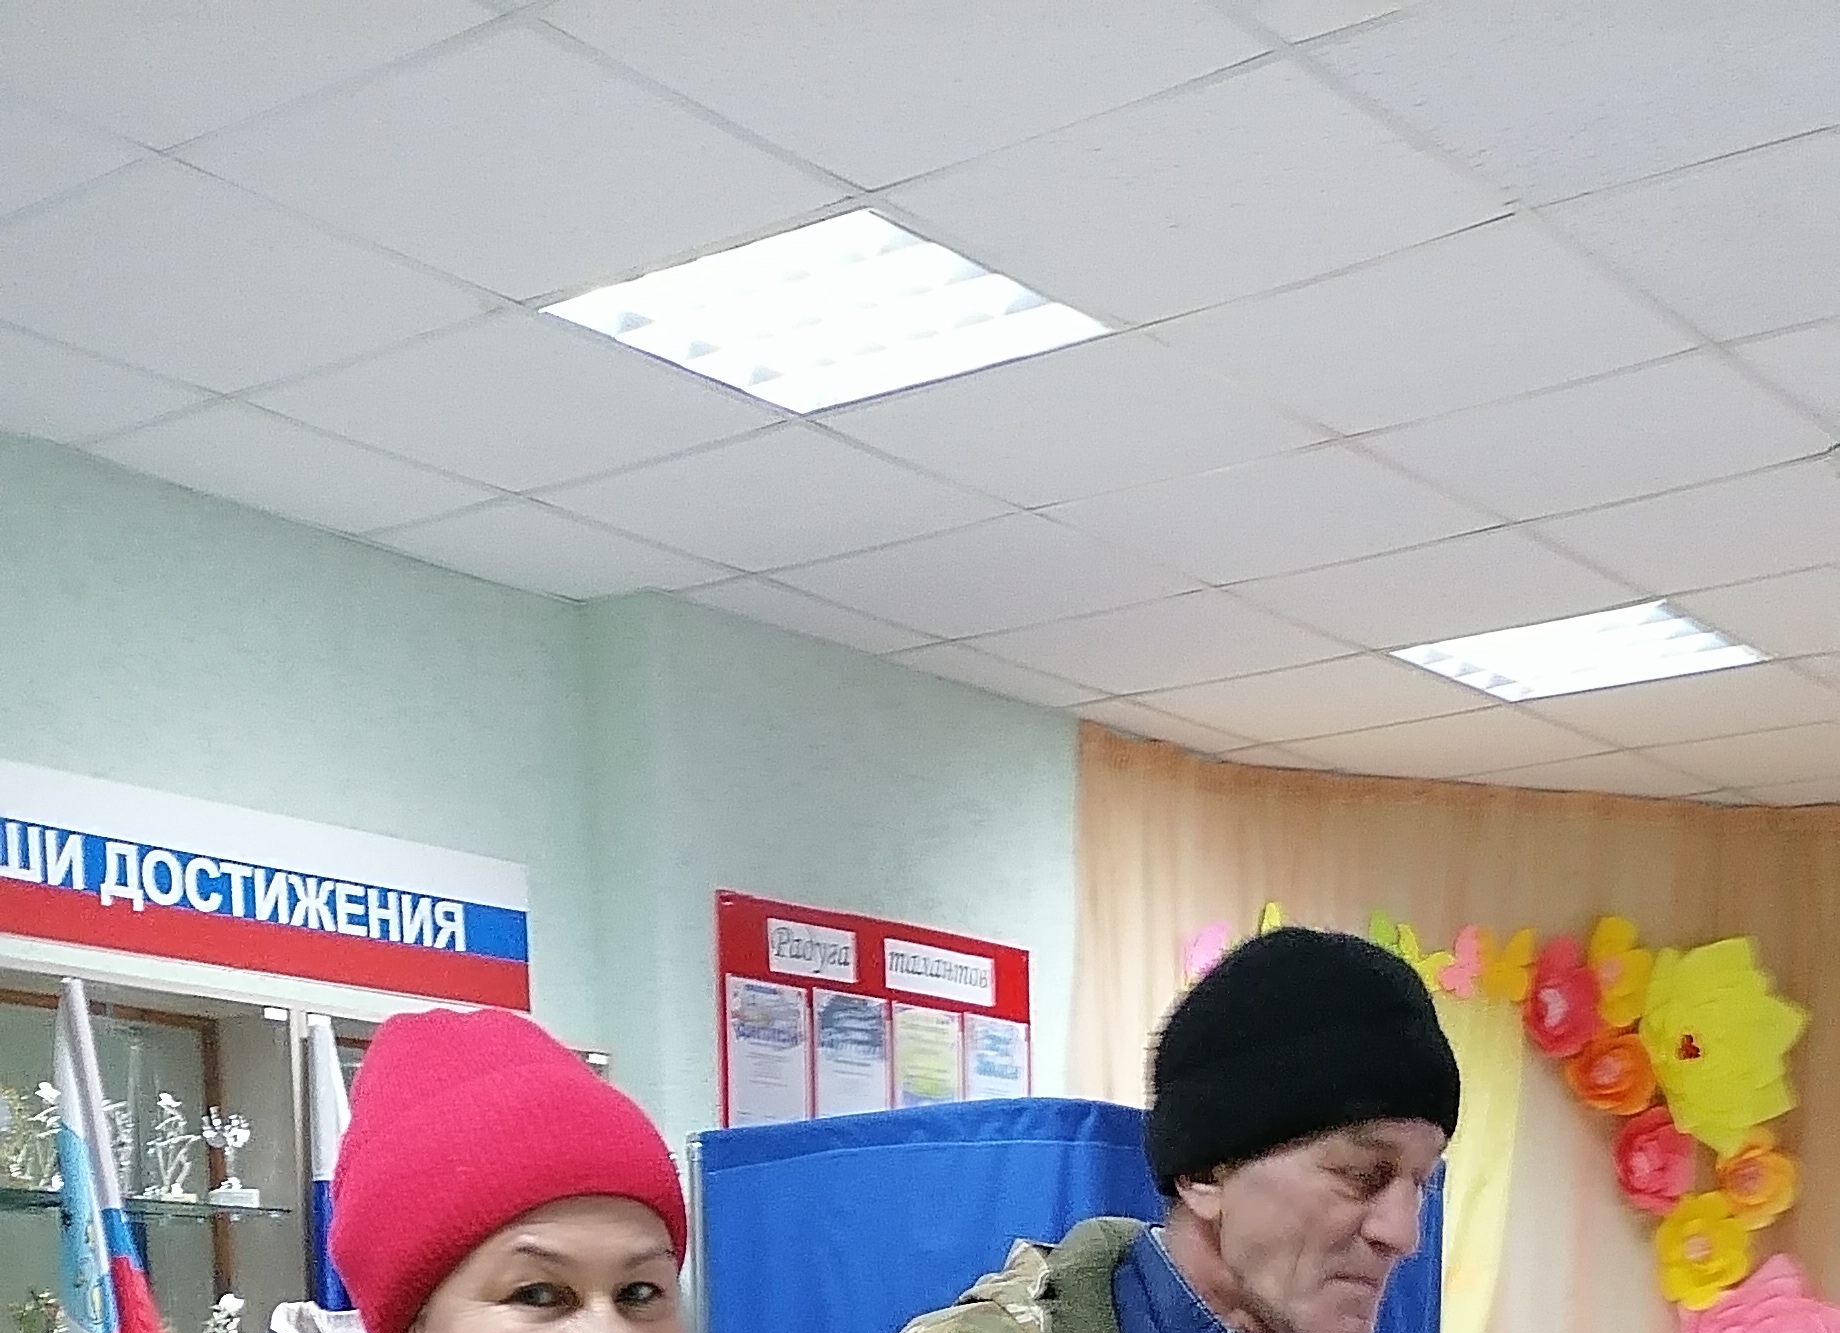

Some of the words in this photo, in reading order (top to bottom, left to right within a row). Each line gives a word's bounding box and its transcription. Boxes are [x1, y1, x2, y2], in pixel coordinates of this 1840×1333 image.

[100, 840, 467, 952] ДОСТИЖЕНИЯ
[771, 926, 851, 974] Радуга
[888, 951, 989, 989] талантов
